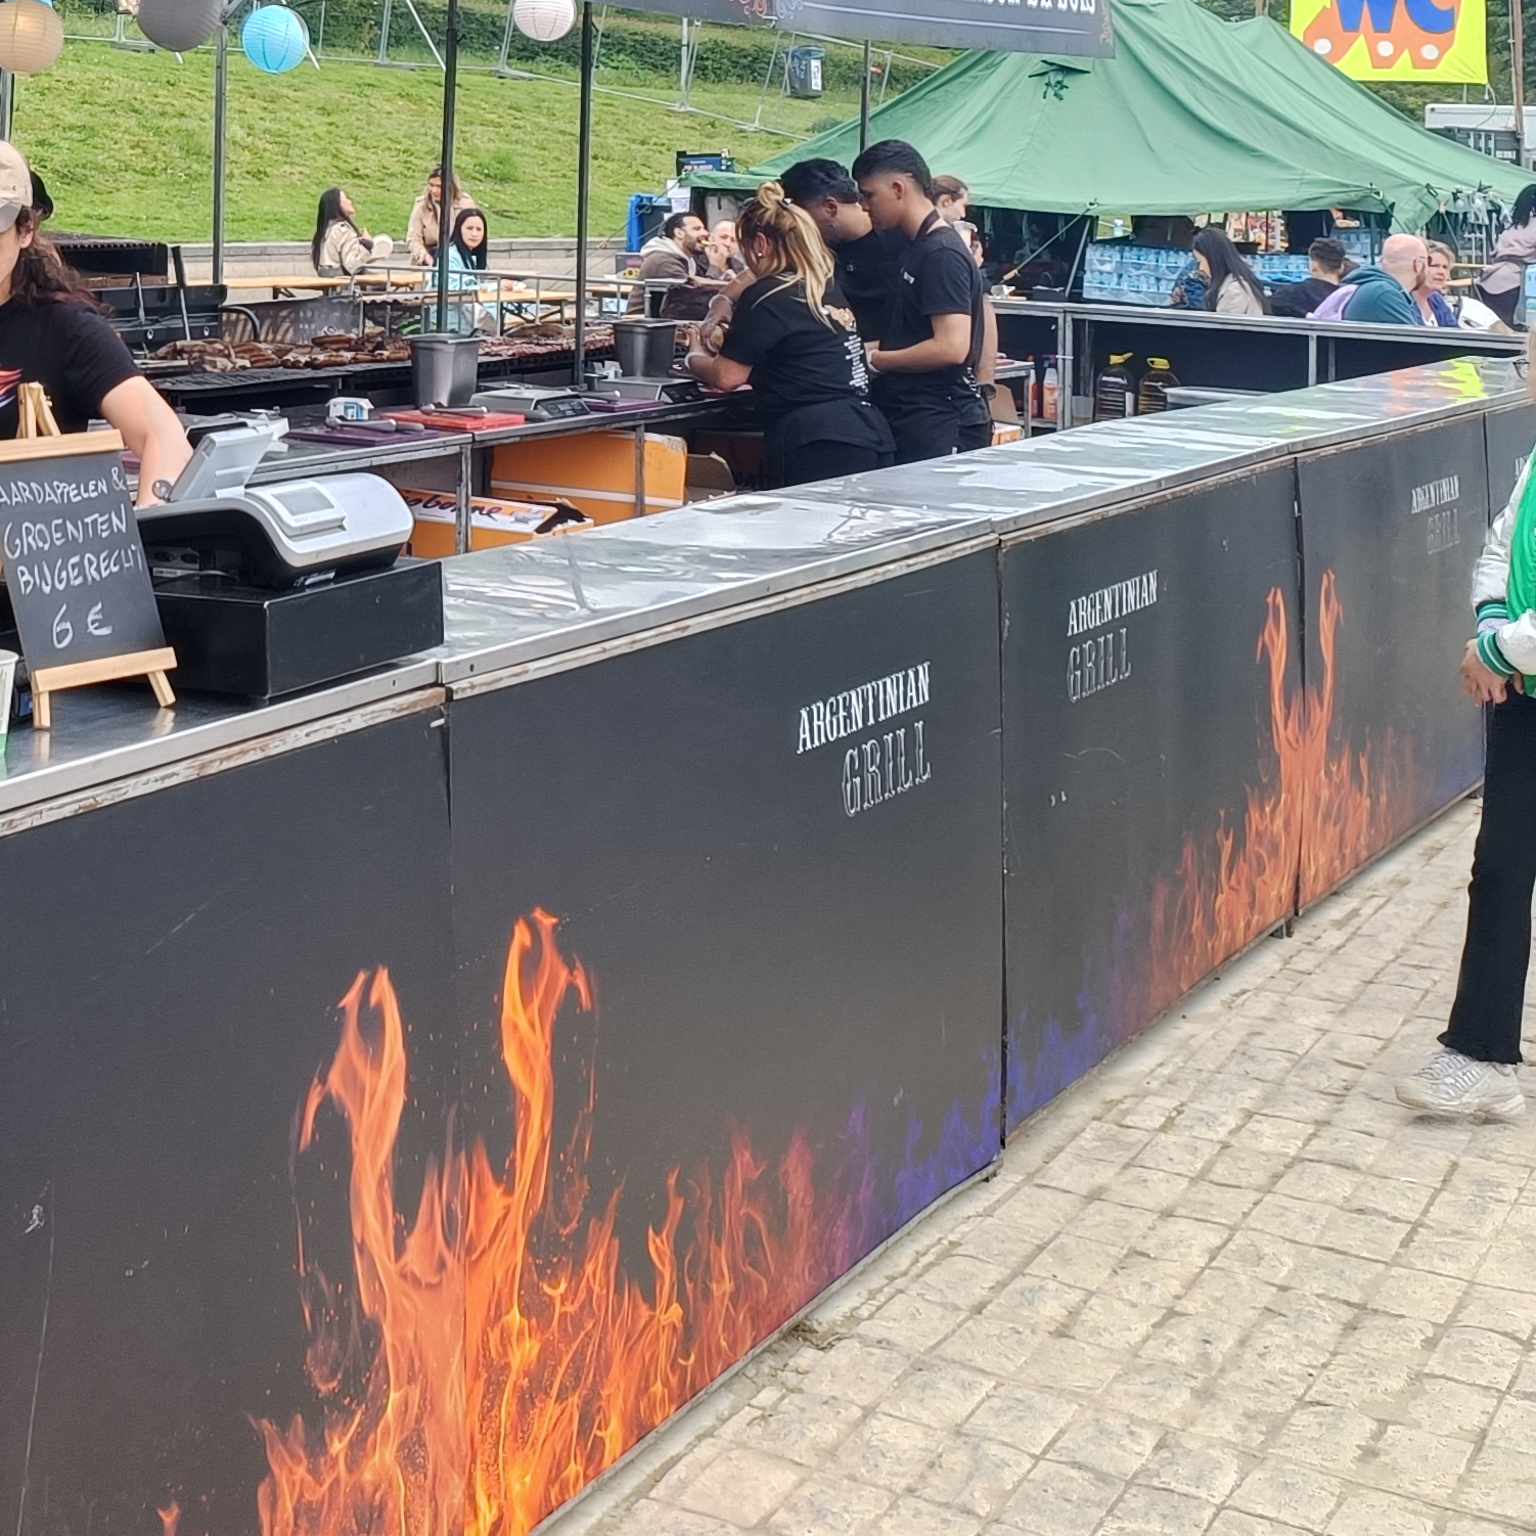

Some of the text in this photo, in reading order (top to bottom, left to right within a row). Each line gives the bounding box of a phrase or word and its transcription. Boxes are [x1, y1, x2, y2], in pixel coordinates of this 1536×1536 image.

[111, 466, 127, 491] &
[4, 503, 127, 559] GROENTEN
[1067, 569, 1158, 637] ARGENTINIAN
[1067, 627, 1132, 704] GRILL
[796, 661, 931, 754] ARGENTINIAN
[841, 720, 932, 817] GRILL
